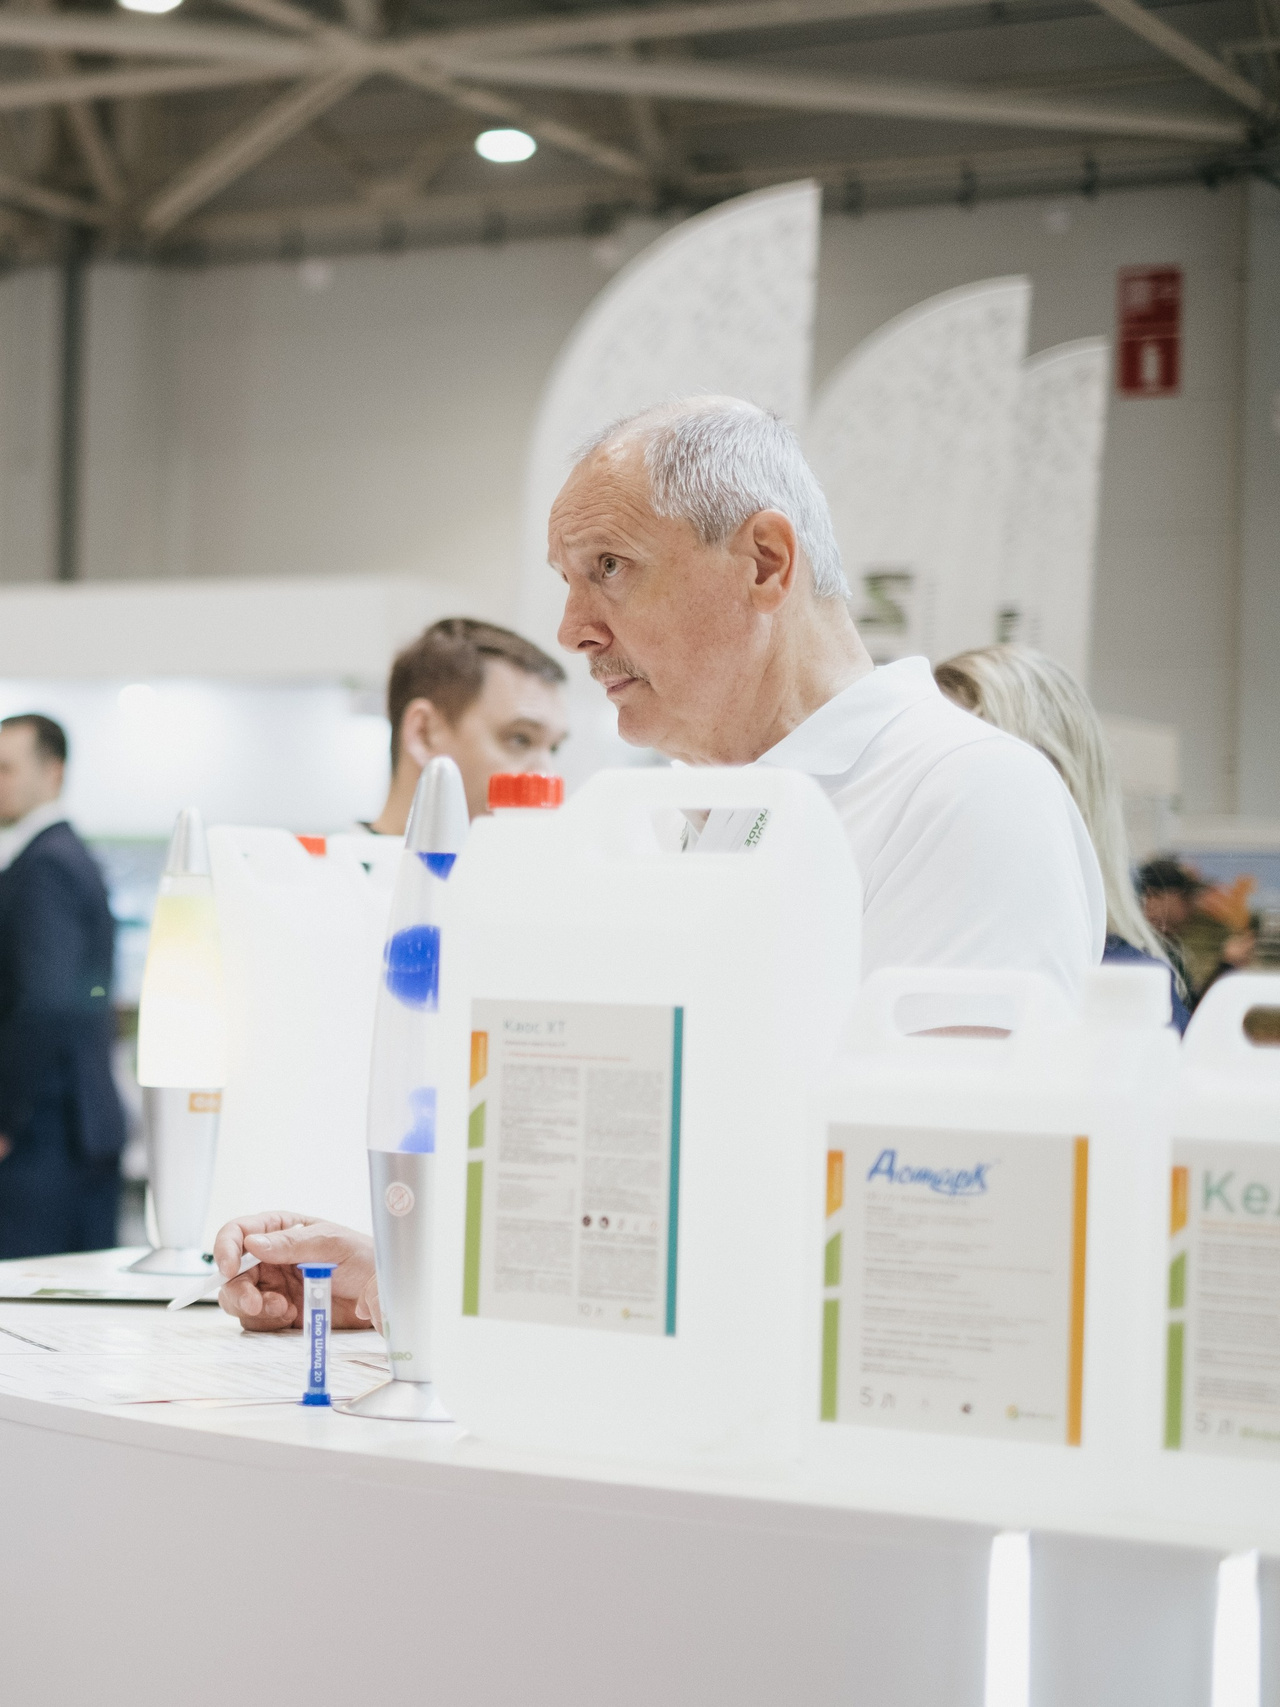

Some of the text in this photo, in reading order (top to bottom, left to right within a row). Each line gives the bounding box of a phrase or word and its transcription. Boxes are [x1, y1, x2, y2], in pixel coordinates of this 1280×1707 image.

[314, 1313, 324, 1383] Блю Шилд 20
